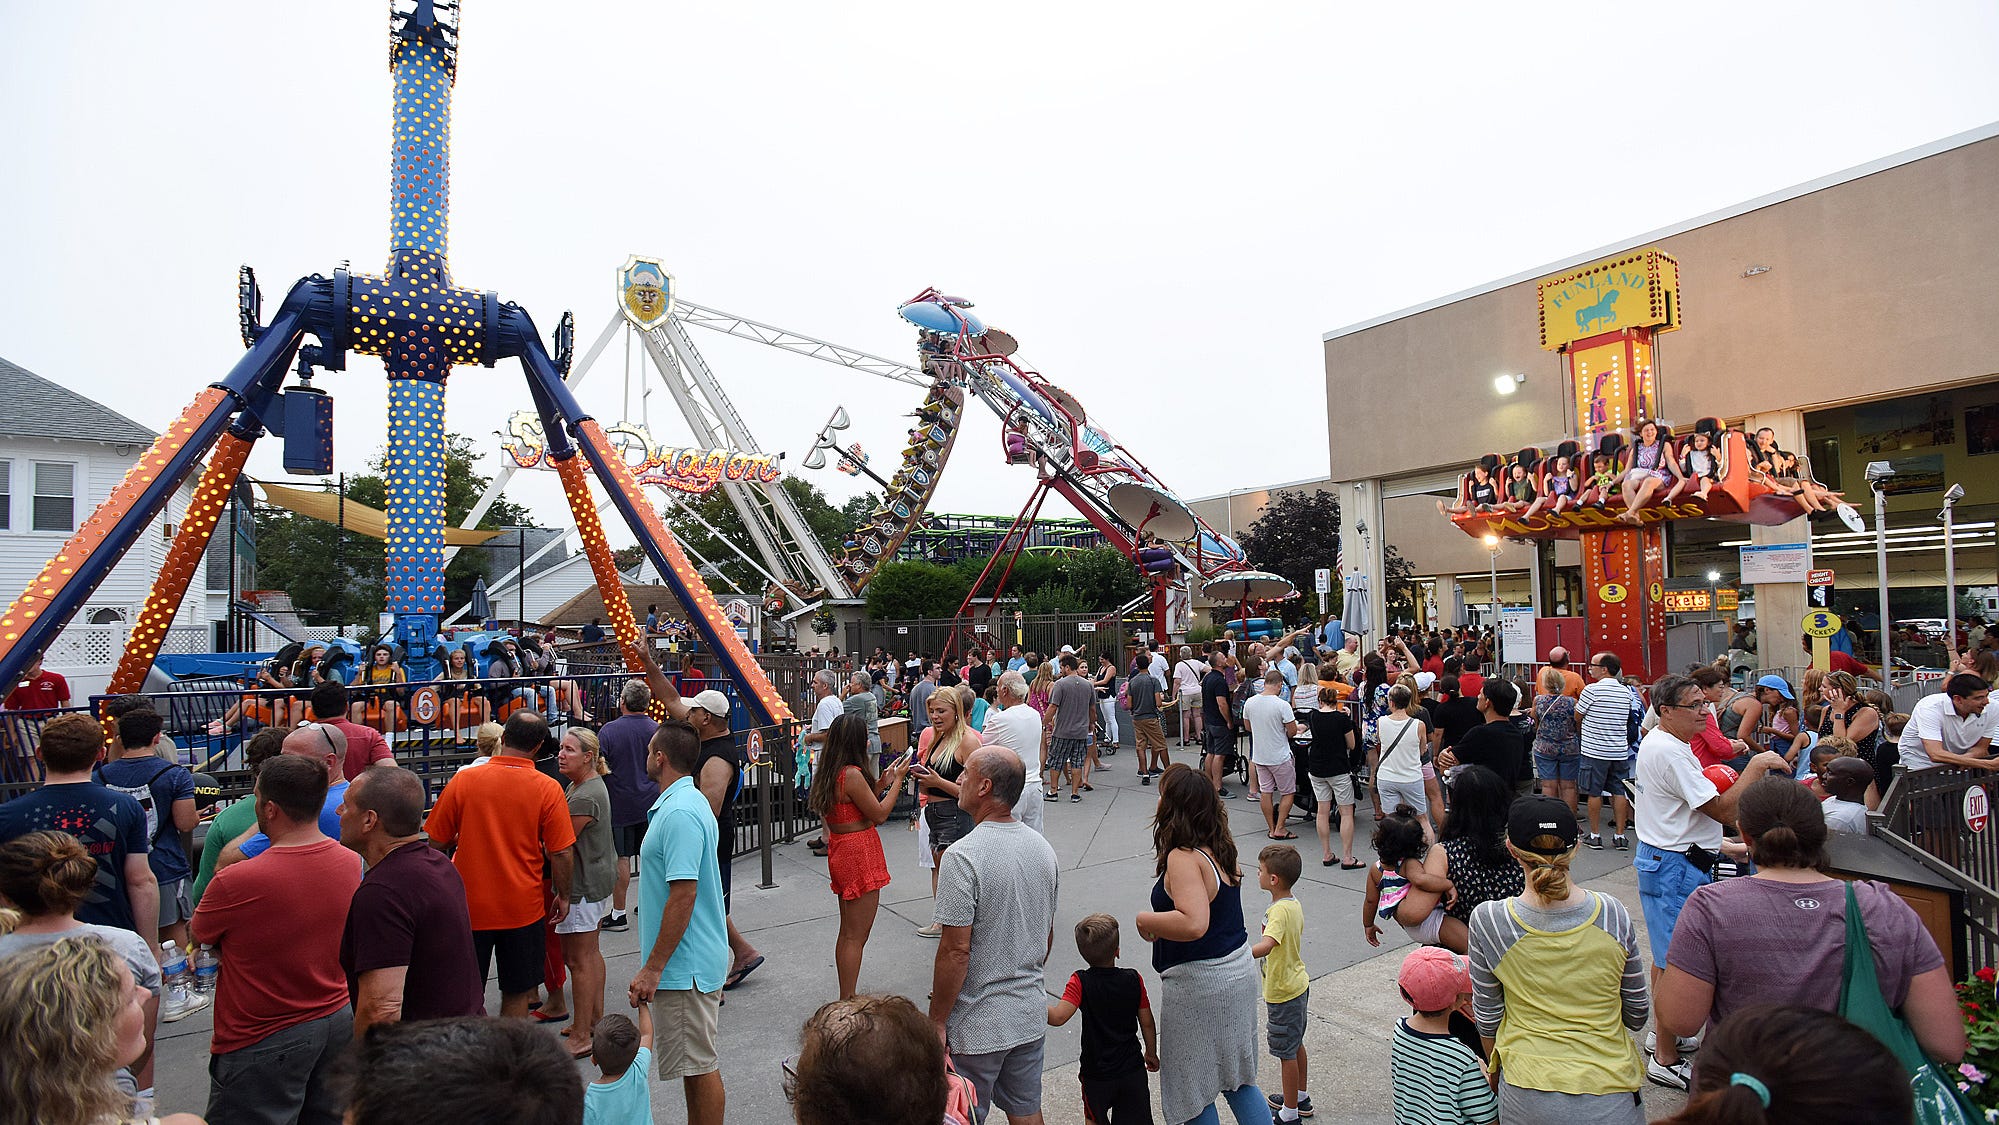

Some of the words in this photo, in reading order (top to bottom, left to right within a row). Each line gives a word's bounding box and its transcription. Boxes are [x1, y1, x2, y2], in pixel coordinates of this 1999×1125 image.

[1552, 271, 1645, 309] FUNLAND
[605, 421, 781, 494] Dragon
[1319, 571, 1323, 579] 4
[1608, 585, 1618, 596] 3
[1666, 595, 1705, 607] ckets
[1814, 613, 1829, 629] 3
[1808, 627, 1836, 635] TICKETS
[1916, 672, 1943, 681] EXIT
[417, 691, 434, 720] 6
[751, 733, 760, 760] 6
[1969, 794, 1984, 817] EXIT
